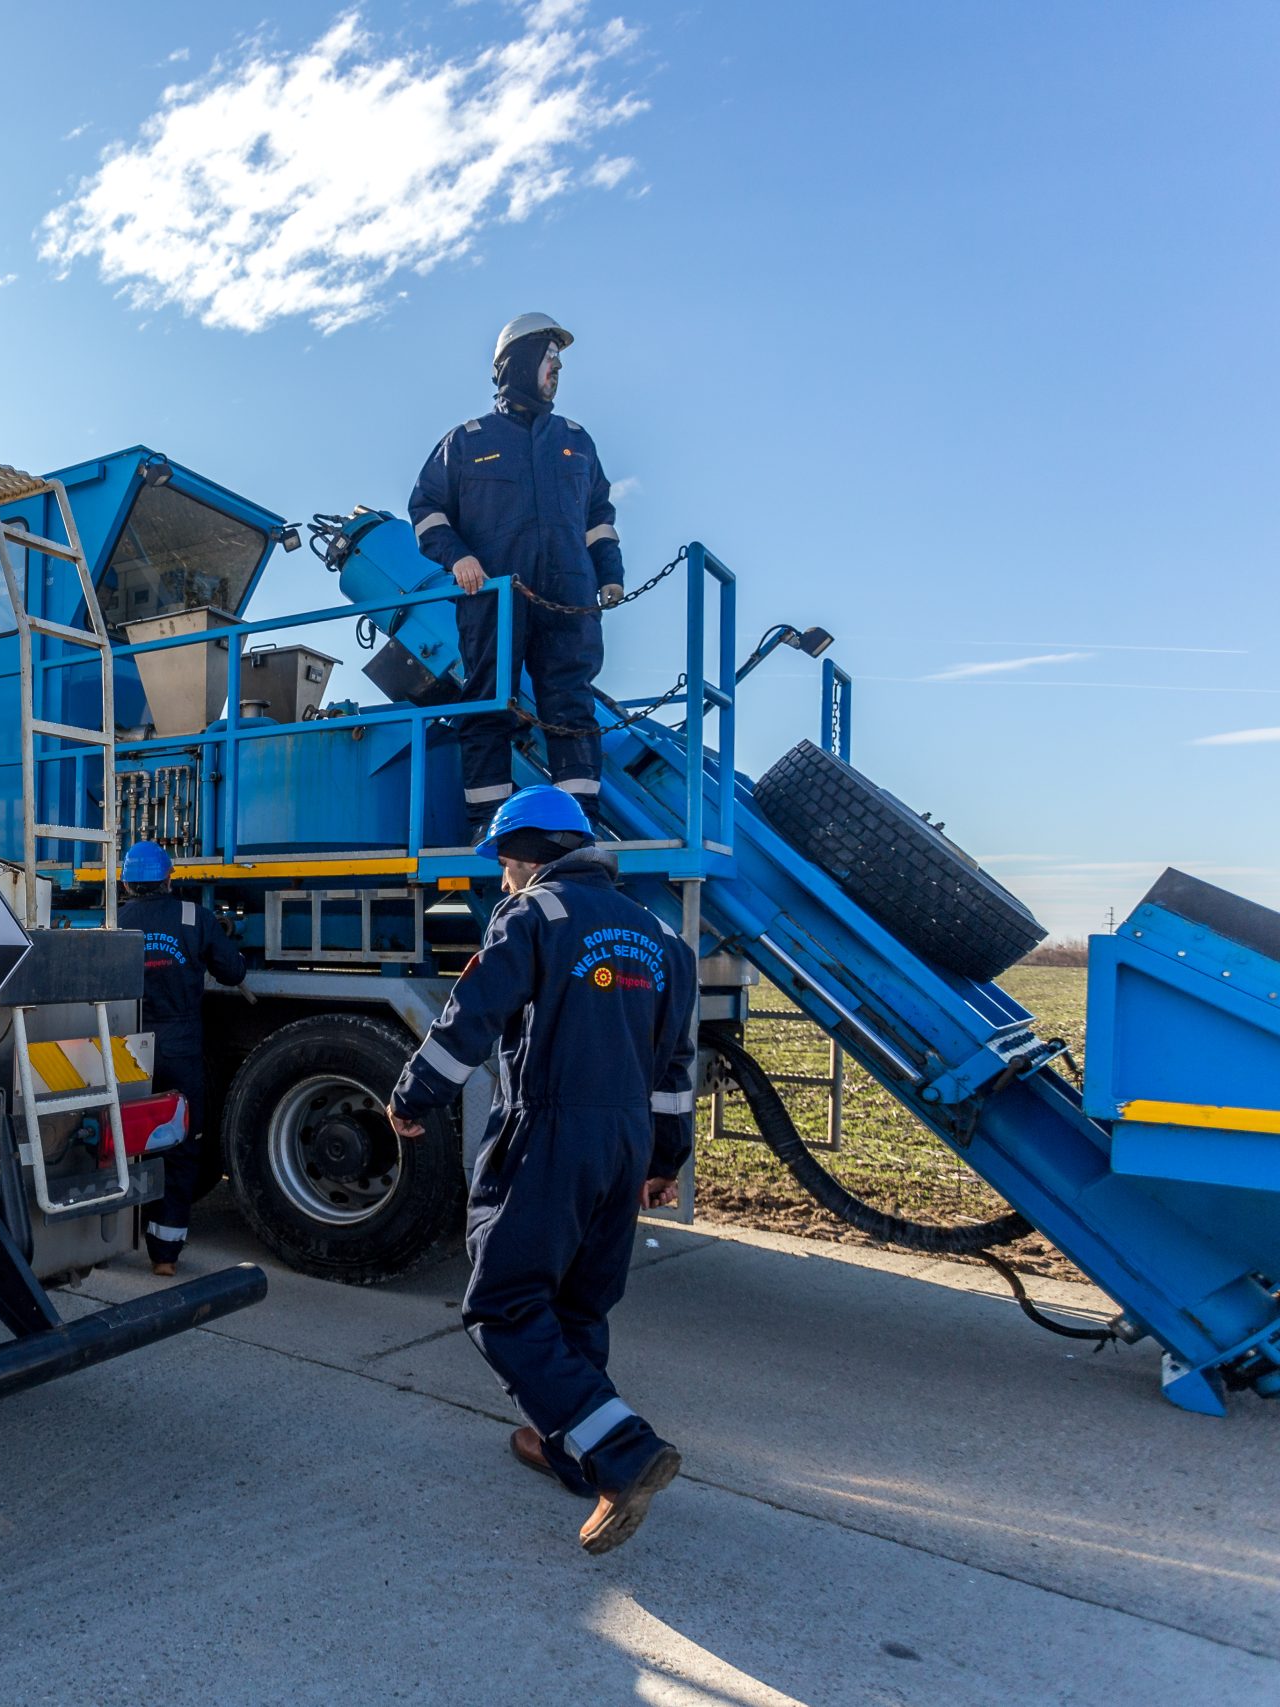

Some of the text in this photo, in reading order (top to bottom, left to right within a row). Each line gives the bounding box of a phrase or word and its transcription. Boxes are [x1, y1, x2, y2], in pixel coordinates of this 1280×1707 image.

[583, 928, 665, 962] ROMPETROL
[571, 944, 666, 993] WELL SERVICES
